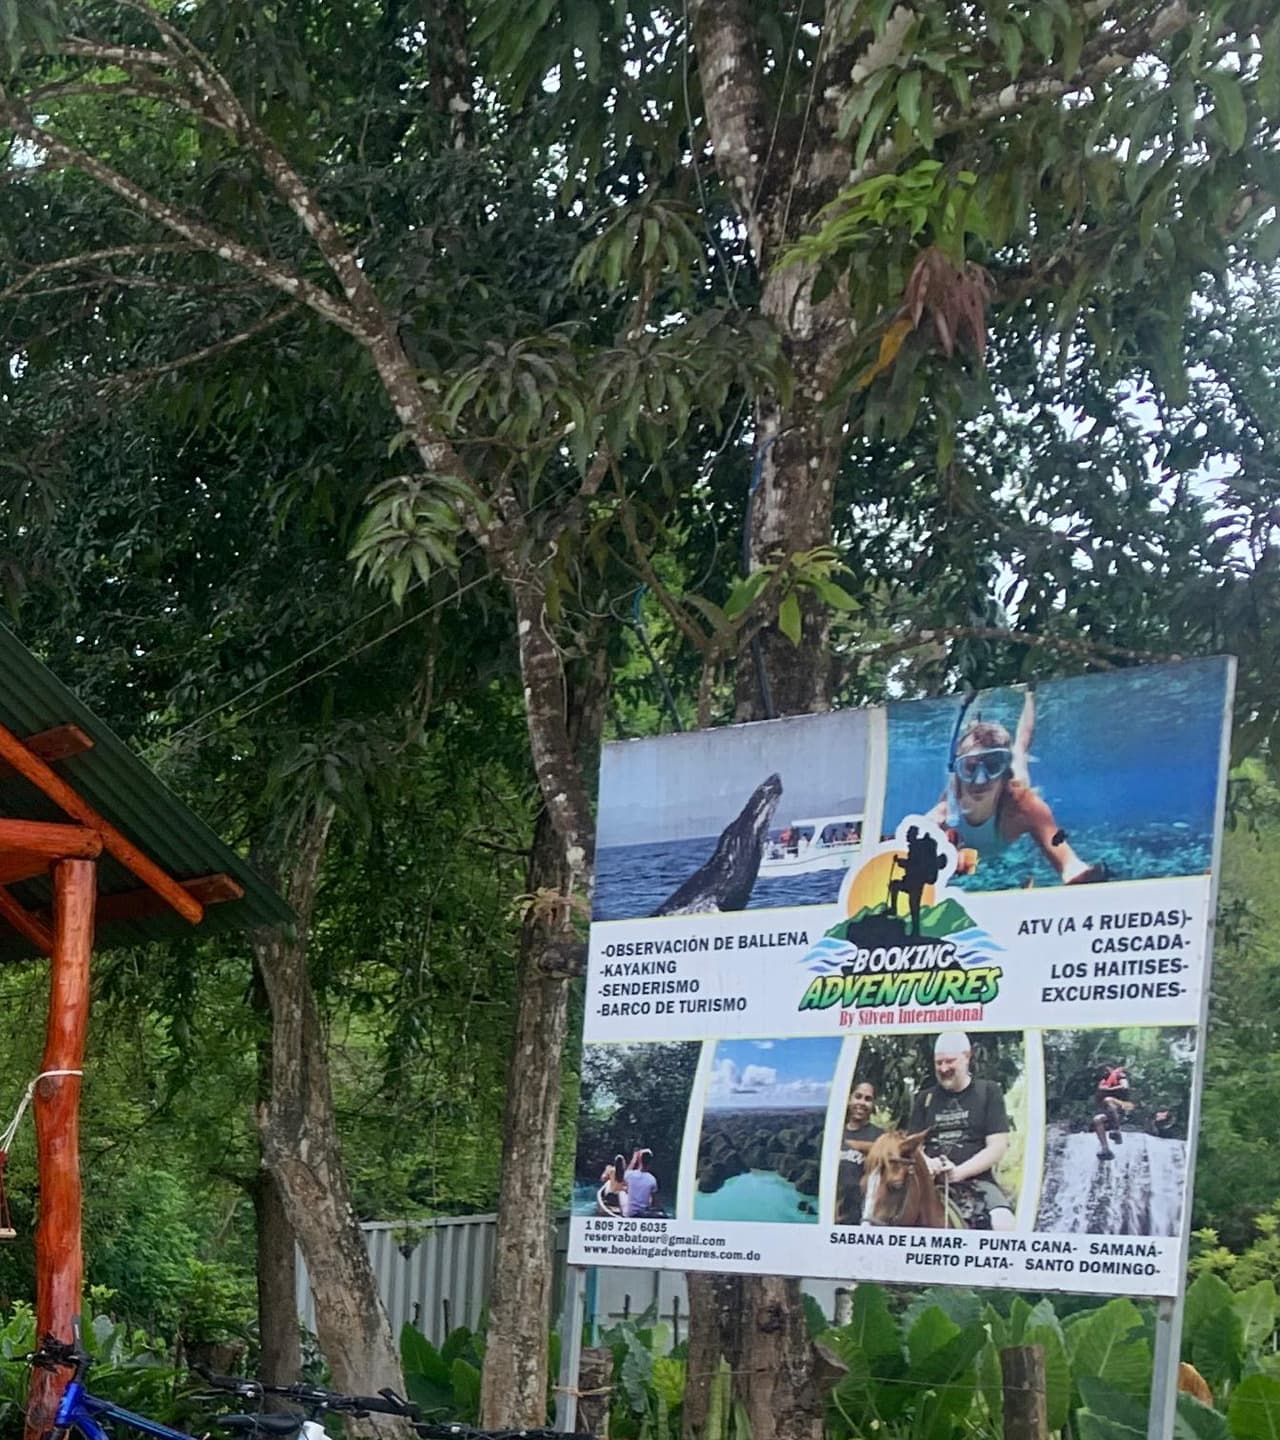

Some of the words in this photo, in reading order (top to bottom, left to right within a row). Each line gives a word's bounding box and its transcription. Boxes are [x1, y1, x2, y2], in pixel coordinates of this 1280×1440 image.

[1017, 918, 1053, 935] ATV
[1058, 917, 1076, 936] (A
[1082, 915, 1094, 931] 4
[601, 935, 709, 957] -OBSERVACIÓN
[713, 936, 734, 950] DE
[738, 931, 809, 949] BALLENA
[1091, 934, 1191, 953] CASCADA-
[600, 960, 677, 977] -KAYAKING
[852, 944, 957, 974] BOOKING
[1051, 963, 1087, 979] LOS
[1094, 958, 1189, 977] HAITISES-
[598, 979, 700, 997] -SENDERISMO
[798, 966, 1003, 1012] ADVENTURES
[1041, 981, 1187, 1003] EXCURSIONES-
[596, 1001, 650, 1017] -BARCO
[655, 1000, 675, 1014] DE
[680, 997, 747, 1013] TURISMO
[839, 1011, 853, 1028] By
[899, 1005, 984, 1025] International
[585, 1221, 592, 1231] 1
[594, 1221, 614, 1231] 809
[617, 1222, 638, 1232] 720
[640, 1222, 667, 1232] 6035
[584, 1245, 761, 1261] www.bookingadventures.com.do
[830, 1232, 884, 1247] SABANA
[888, 1235, 906, 1247] DE
[910, 1236, 927, 1248] LA
[930, 1236, 968, 1249] MAR-
[979, 1238, 1027, 1252] PUNTA
[1031, 1240, 1077, 1254] CANA-
[905, 1253, 960, 1267] PUERTO
[964, 1255, 1013, 1269] PLATA-
[1024, 1258, 1074, 1272] SANTO
[1079, 1261, 1160, 1276] DOMINGO-
